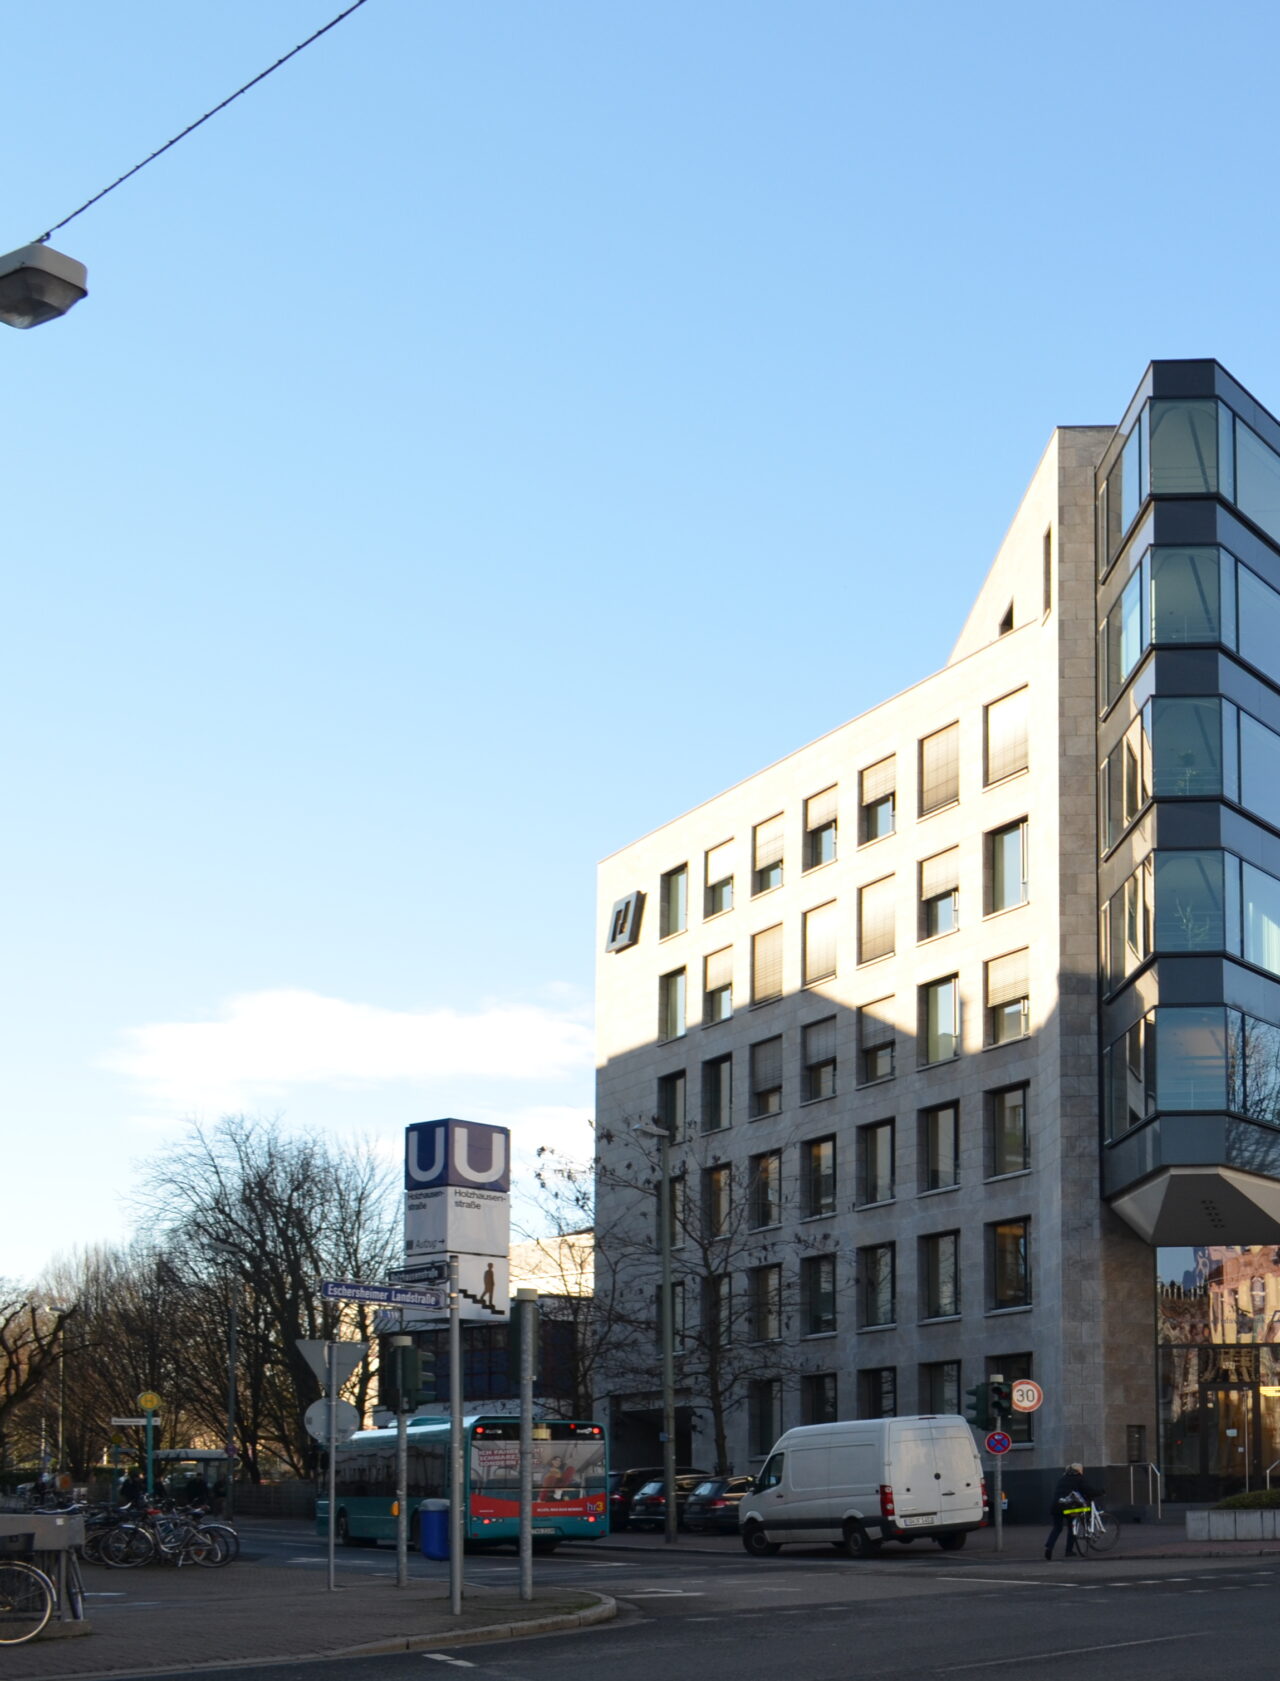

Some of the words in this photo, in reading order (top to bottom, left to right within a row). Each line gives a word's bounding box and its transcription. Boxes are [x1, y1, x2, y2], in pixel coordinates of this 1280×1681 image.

[408, 1127, 444, 1181] U
[454, 1127, 505, 1183] U
[454, 1189, 506, 1202] Holzhausen-
[454, 1200, 482, 1210] straße
[327, 1283, 388, 1300] Eschersheimer
[391, 1290, 436, 1305] Landstraße
[1016, 1389, 1035, 1402] 30
[586, 1501, 604, 1513] hr3
